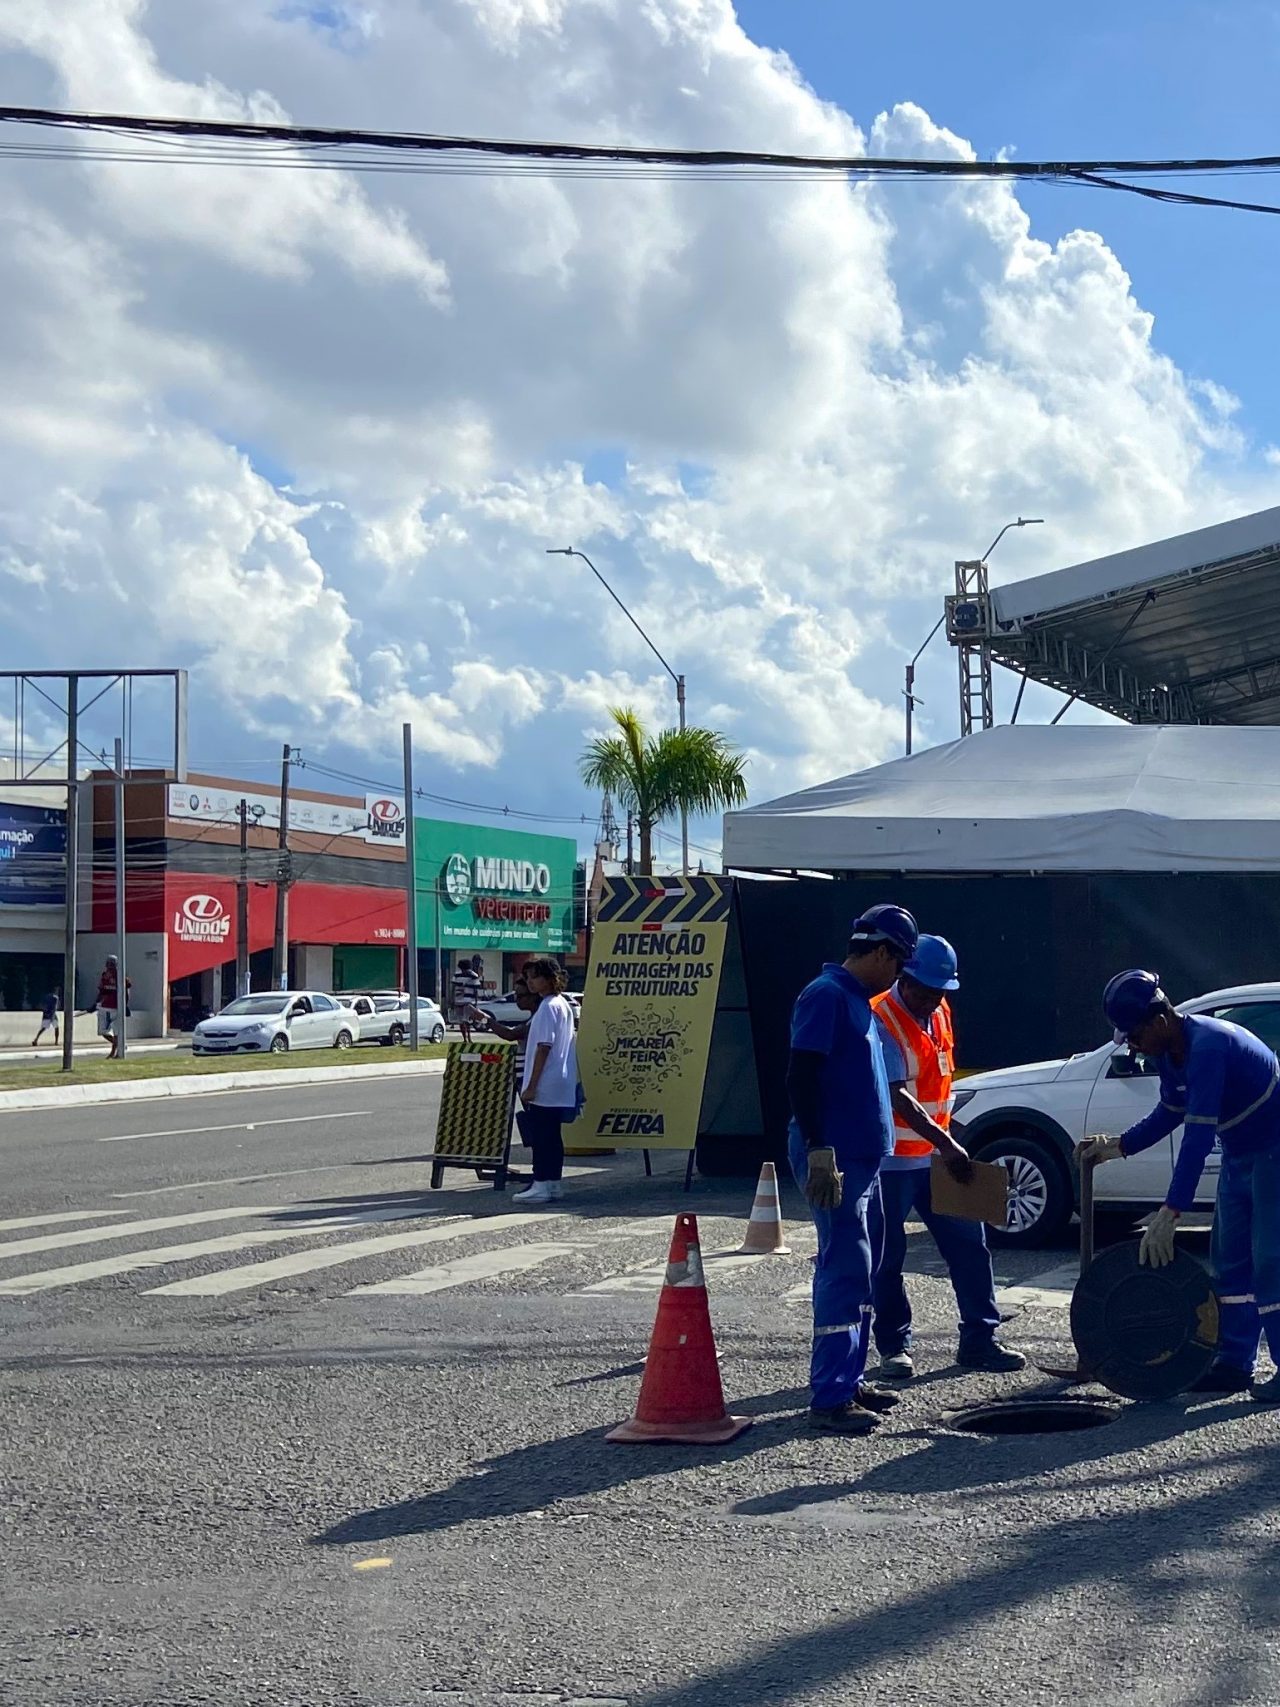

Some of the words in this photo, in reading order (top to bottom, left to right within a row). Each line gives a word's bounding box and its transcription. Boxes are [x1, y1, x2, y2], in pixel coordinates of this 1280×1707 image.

[0, 829, 34, 846] mação
[475, 856, 551, 894] MUNDO
[174, 912, 231, 936] UNIDOS
[612, 929, 706, 960] ATENÇÃO
[596, 963, 681, 978] MONTAGEM
[683, 963, 714, 978] DAS
[605, 981, 699, 996] ESTRUTURAS
[630, 1051, 666, 1067] FEIRA
[597, 1114, 664, 1134] FEIRA
